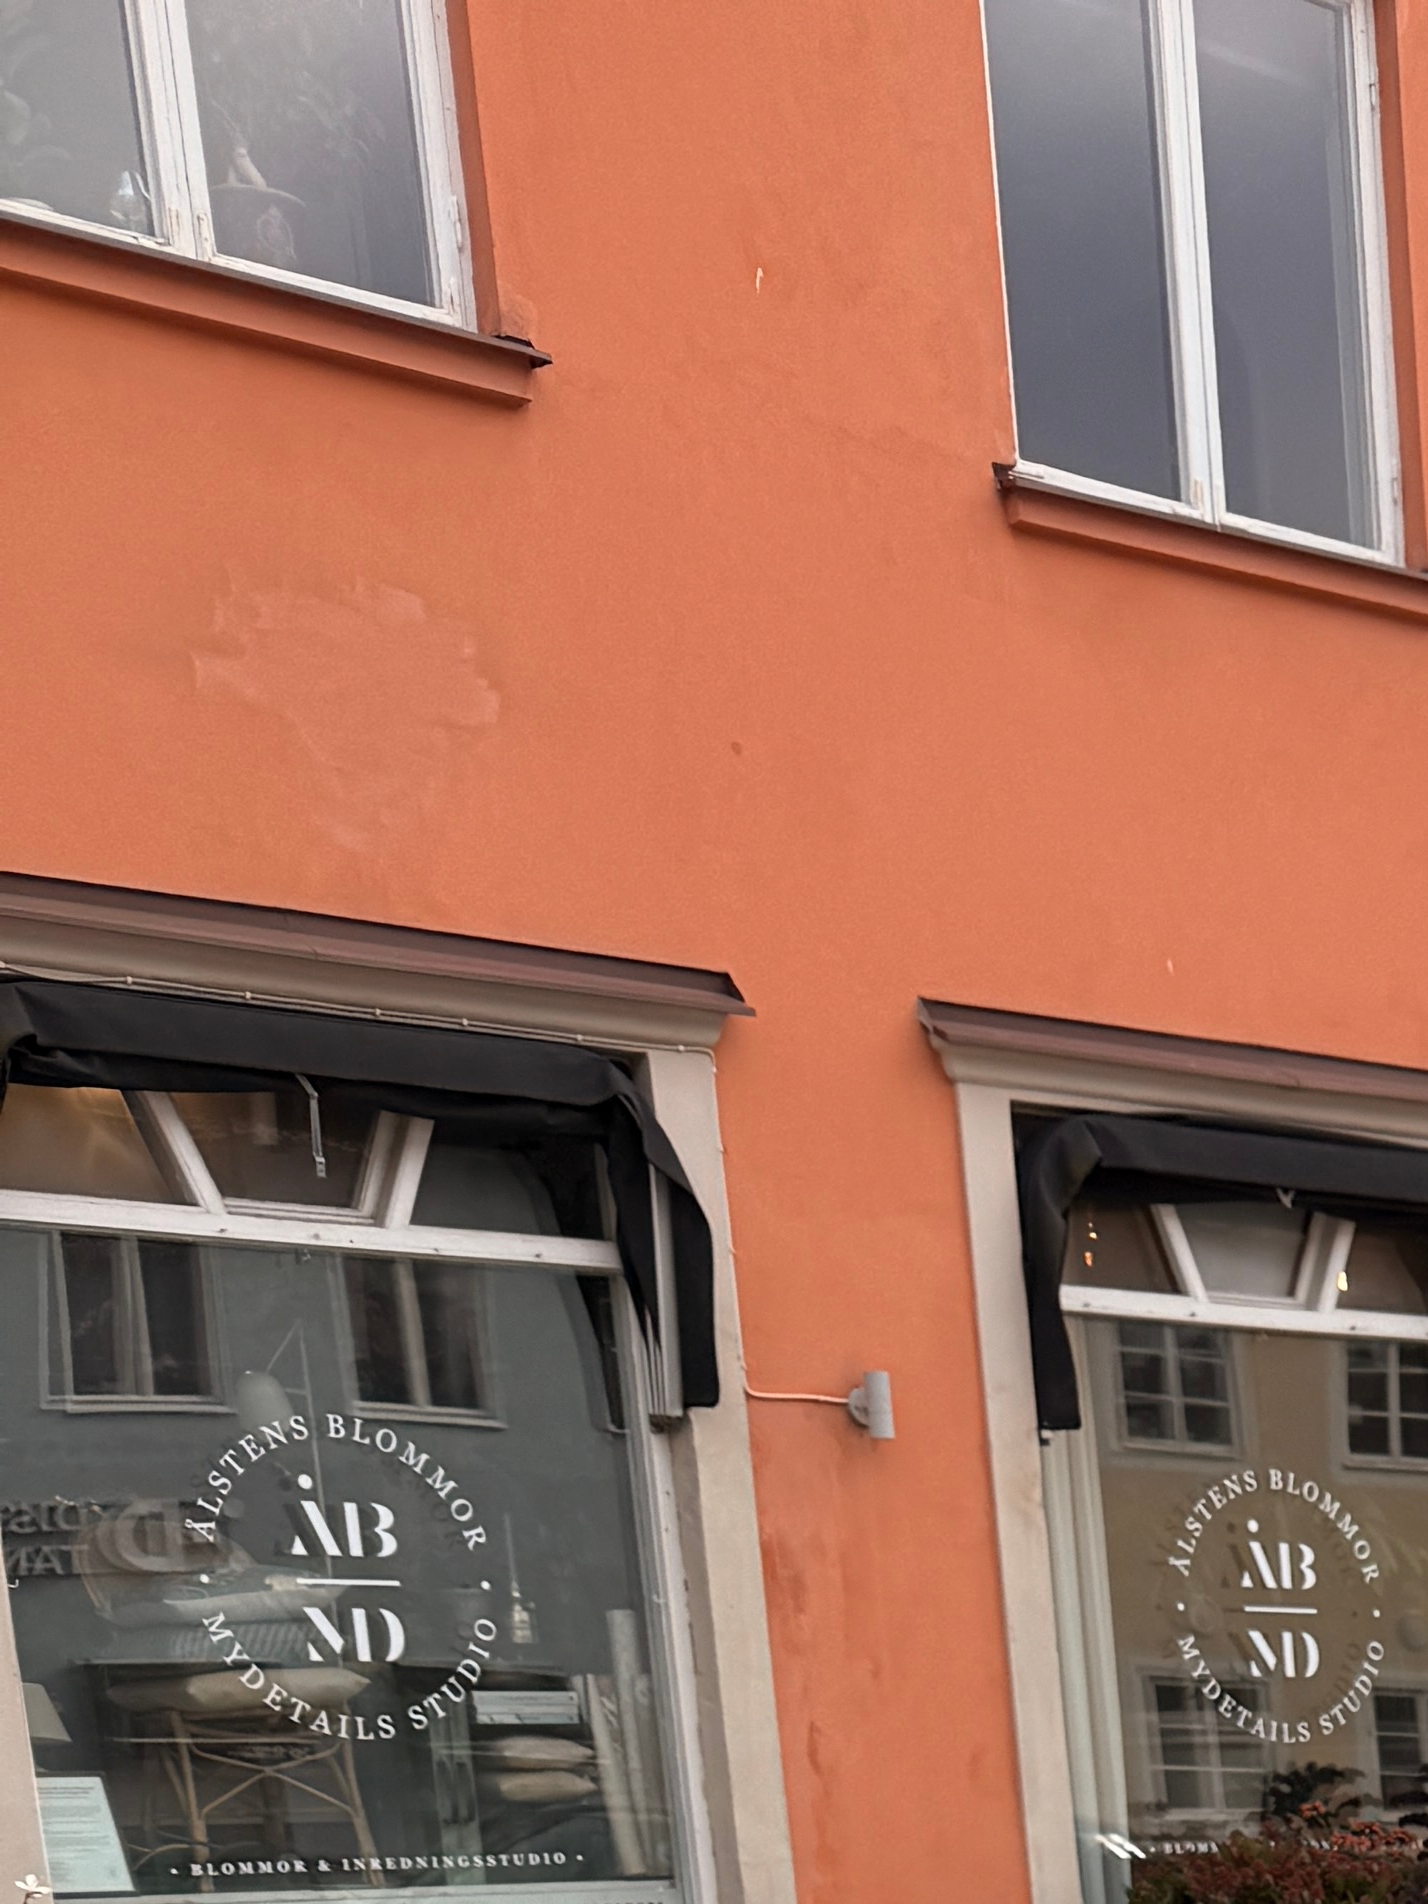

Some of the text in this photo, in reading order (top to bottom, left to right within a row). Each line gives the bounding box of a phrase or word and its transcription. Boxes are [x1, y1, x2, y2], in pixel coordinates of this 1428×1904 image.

[185, 1413, 487, 1550] ÅLSTENS BLOMMOR
[1168, 1469, 1379, 1583] ÅLSTENS BLOMMOR
[202, 1612, 497, 1740] MYDETAILS STUDIO
[1177, 1634, 1384, 1744] MYDETAILS STUDIO
[190, 1852, 567, 1876] BLOMMOR & INREDNINGSSTUDIO
